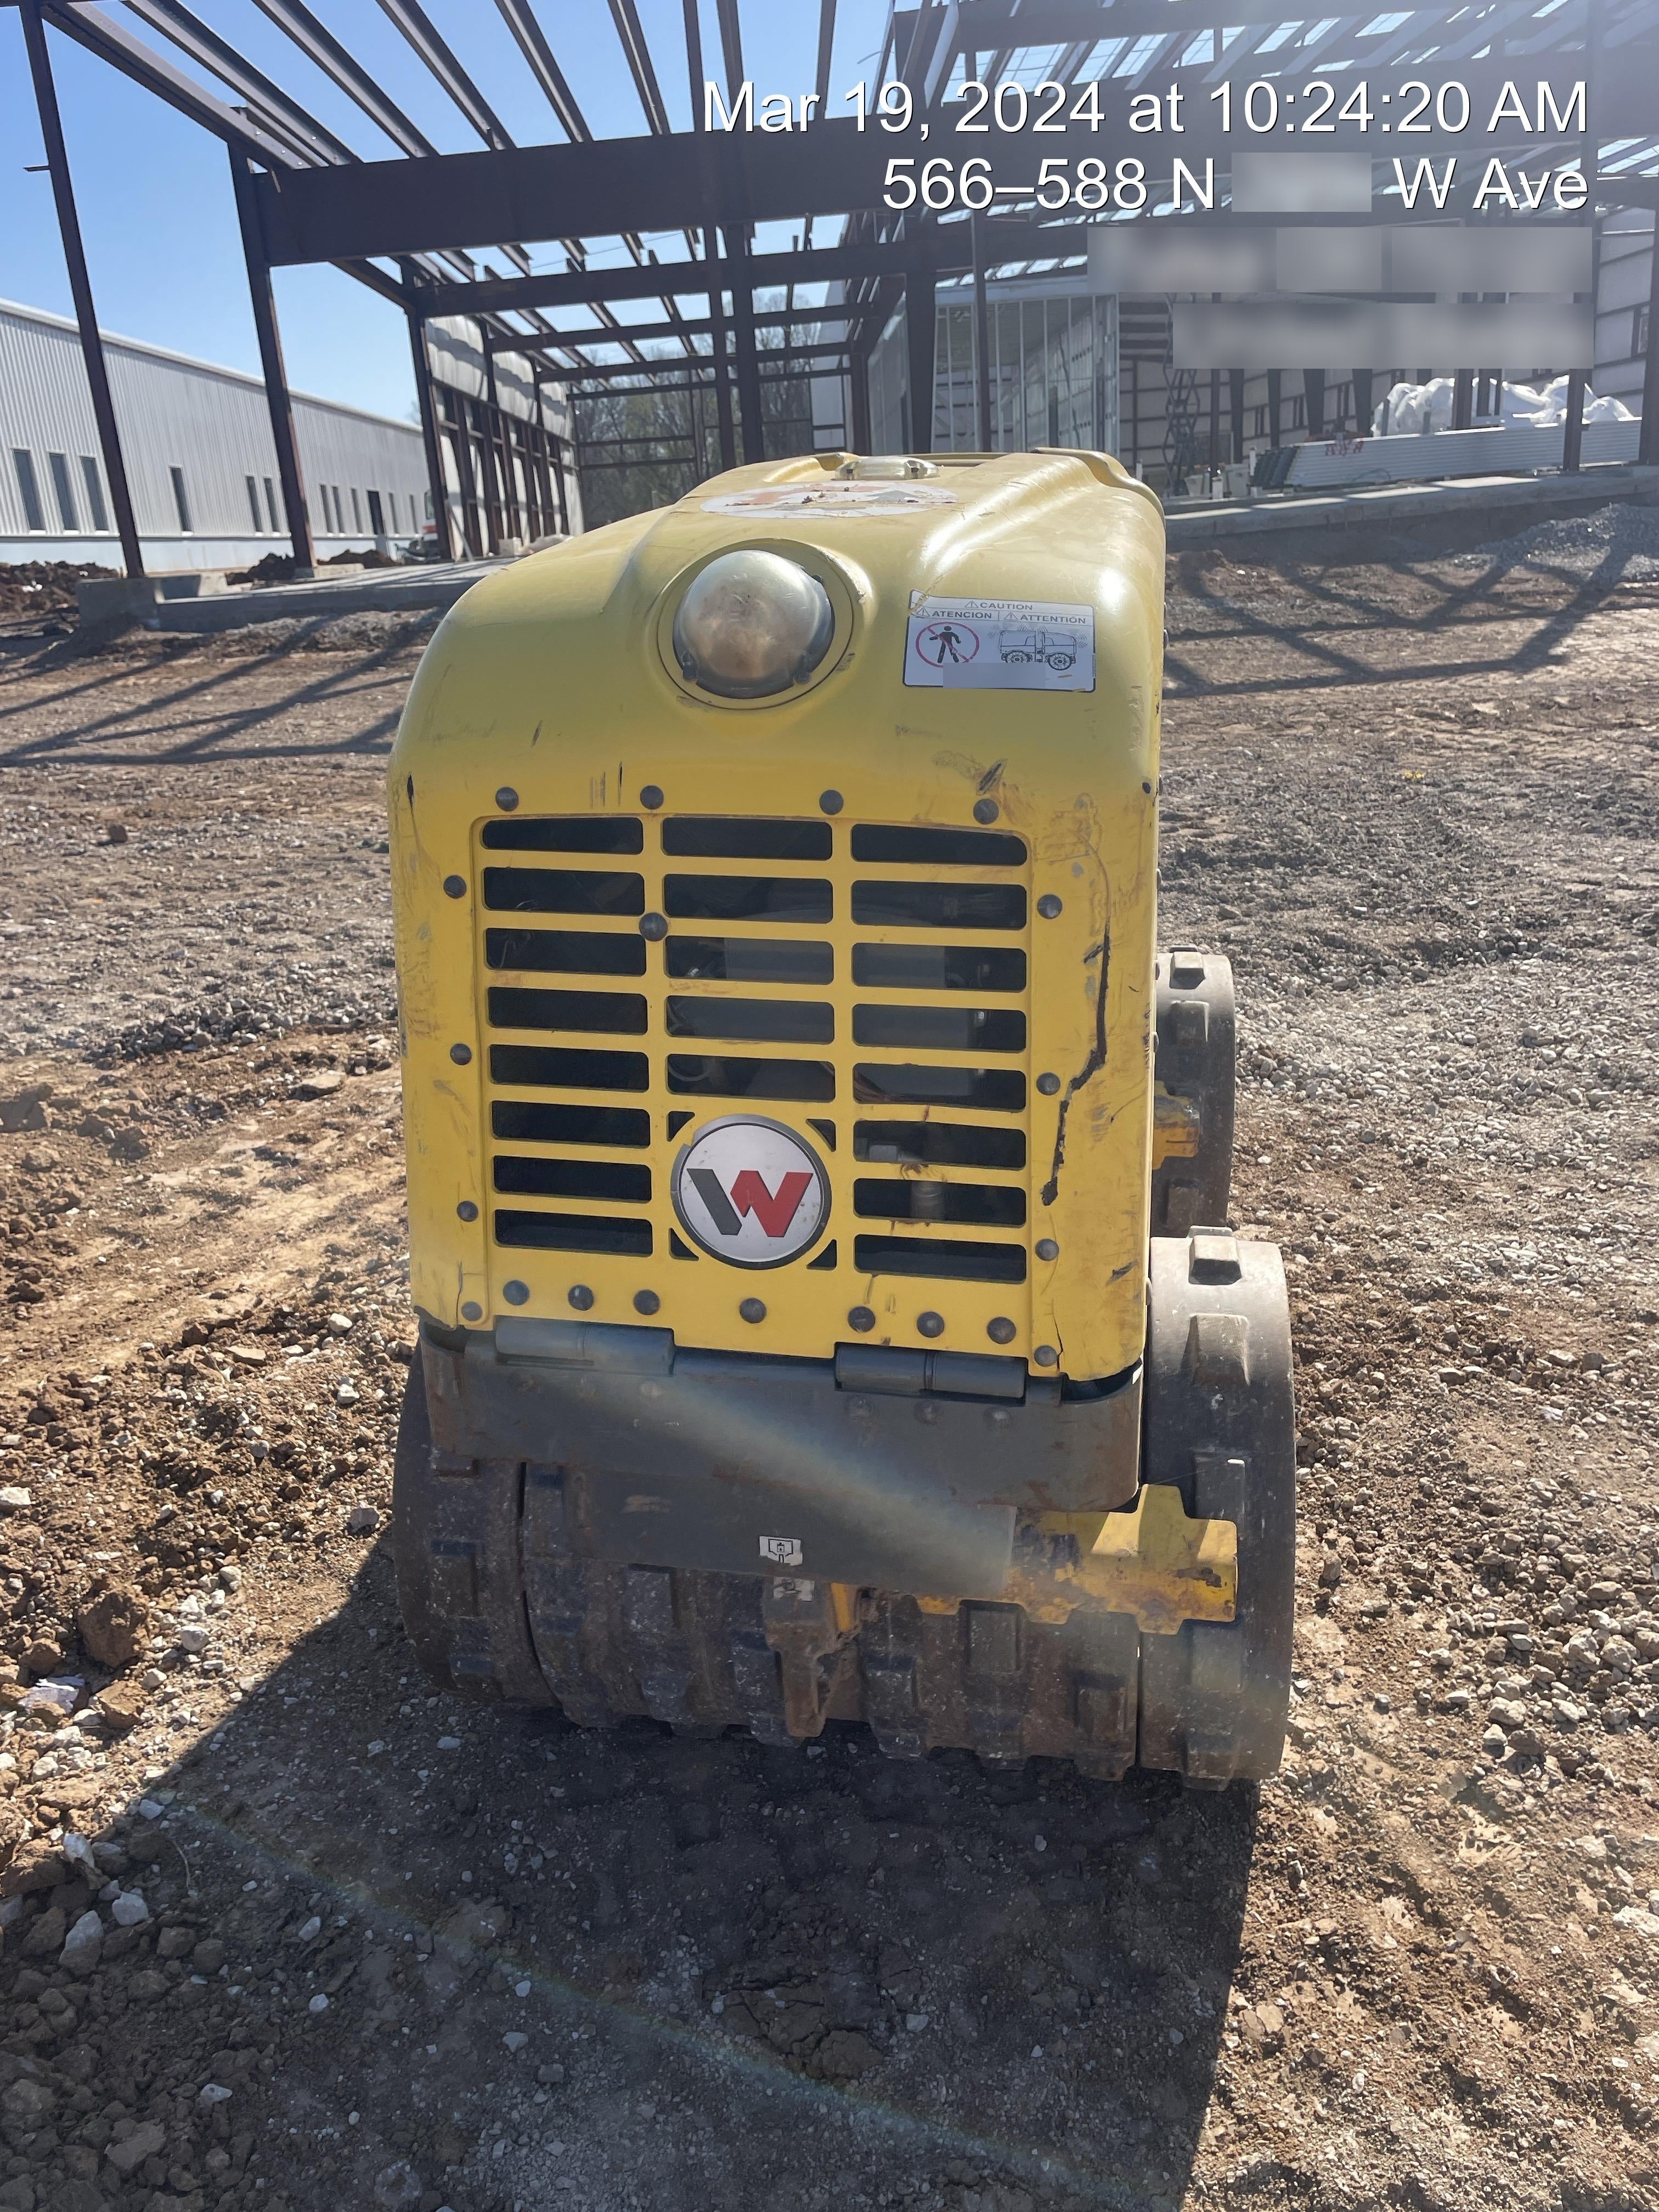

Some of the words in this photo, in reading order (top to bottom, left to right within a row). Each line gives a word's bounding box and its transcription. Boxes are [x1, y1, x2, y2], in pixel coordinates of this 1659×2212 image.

[980, 602, 1033, 611] CAUTION
[932, 610, 992, 619] ATENCION
[686, 1167, 814, 1238] W
